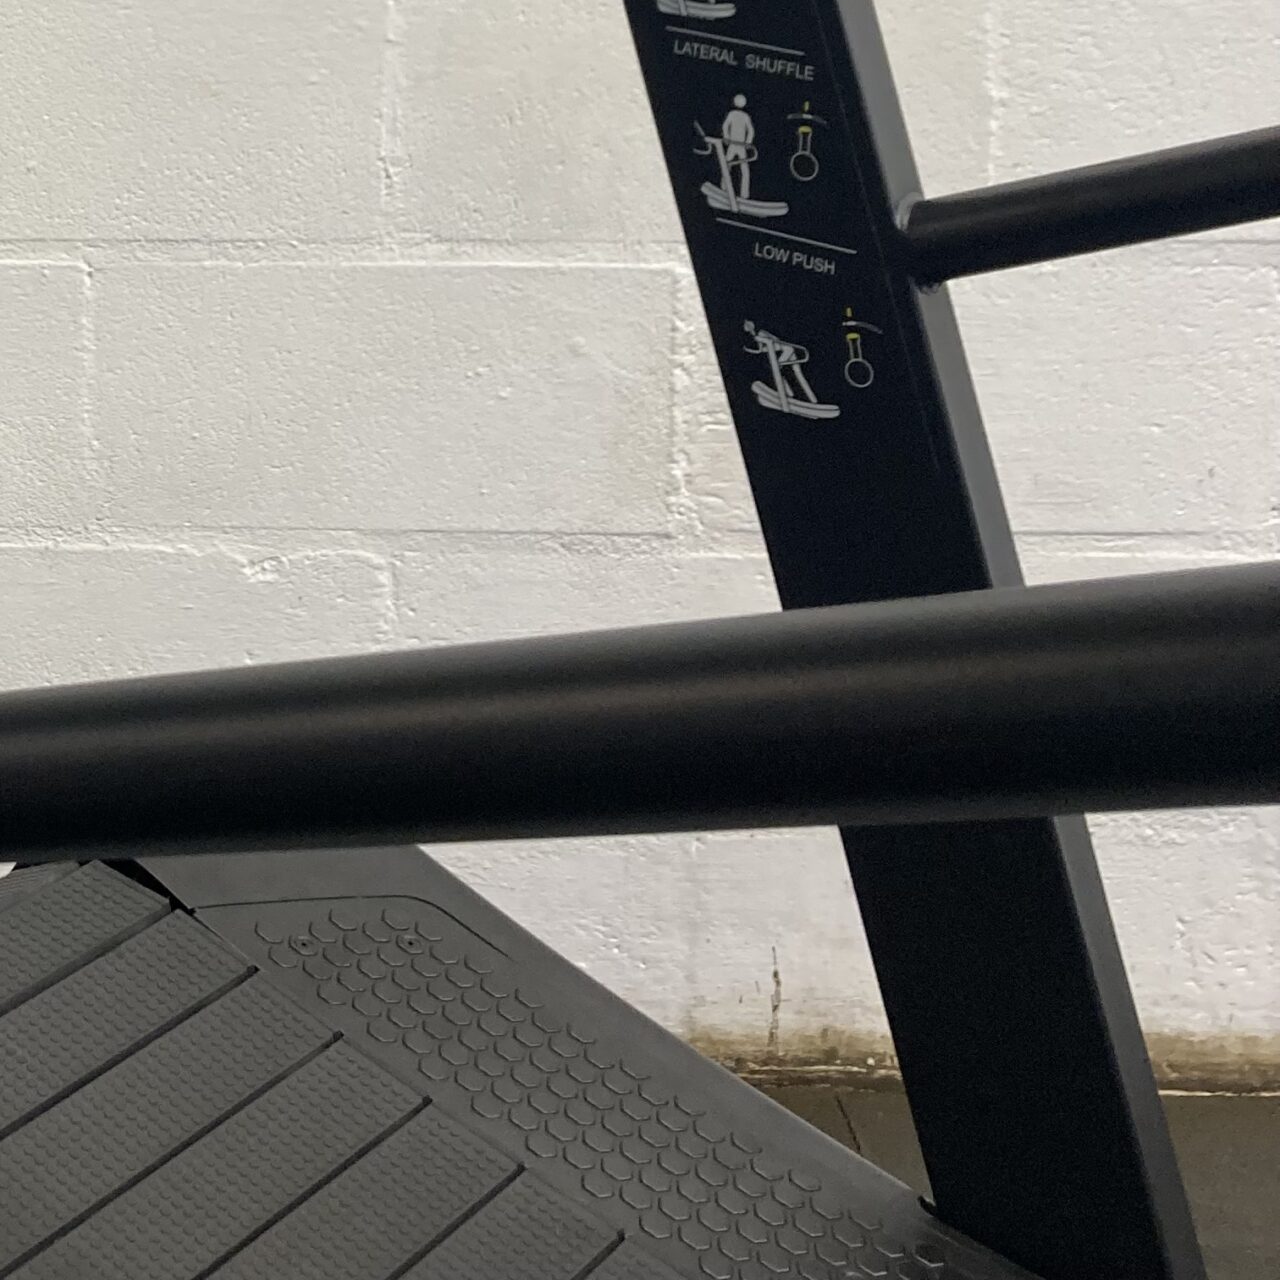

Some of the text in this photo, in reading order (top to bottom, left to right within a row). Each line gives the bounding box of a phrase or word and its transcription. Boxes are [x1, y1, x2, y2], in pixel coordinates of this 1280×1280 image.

[673, 40, 815, 81] LATERAL SHUFFLE
[753, 242, 836, 275] LOW PUSH
